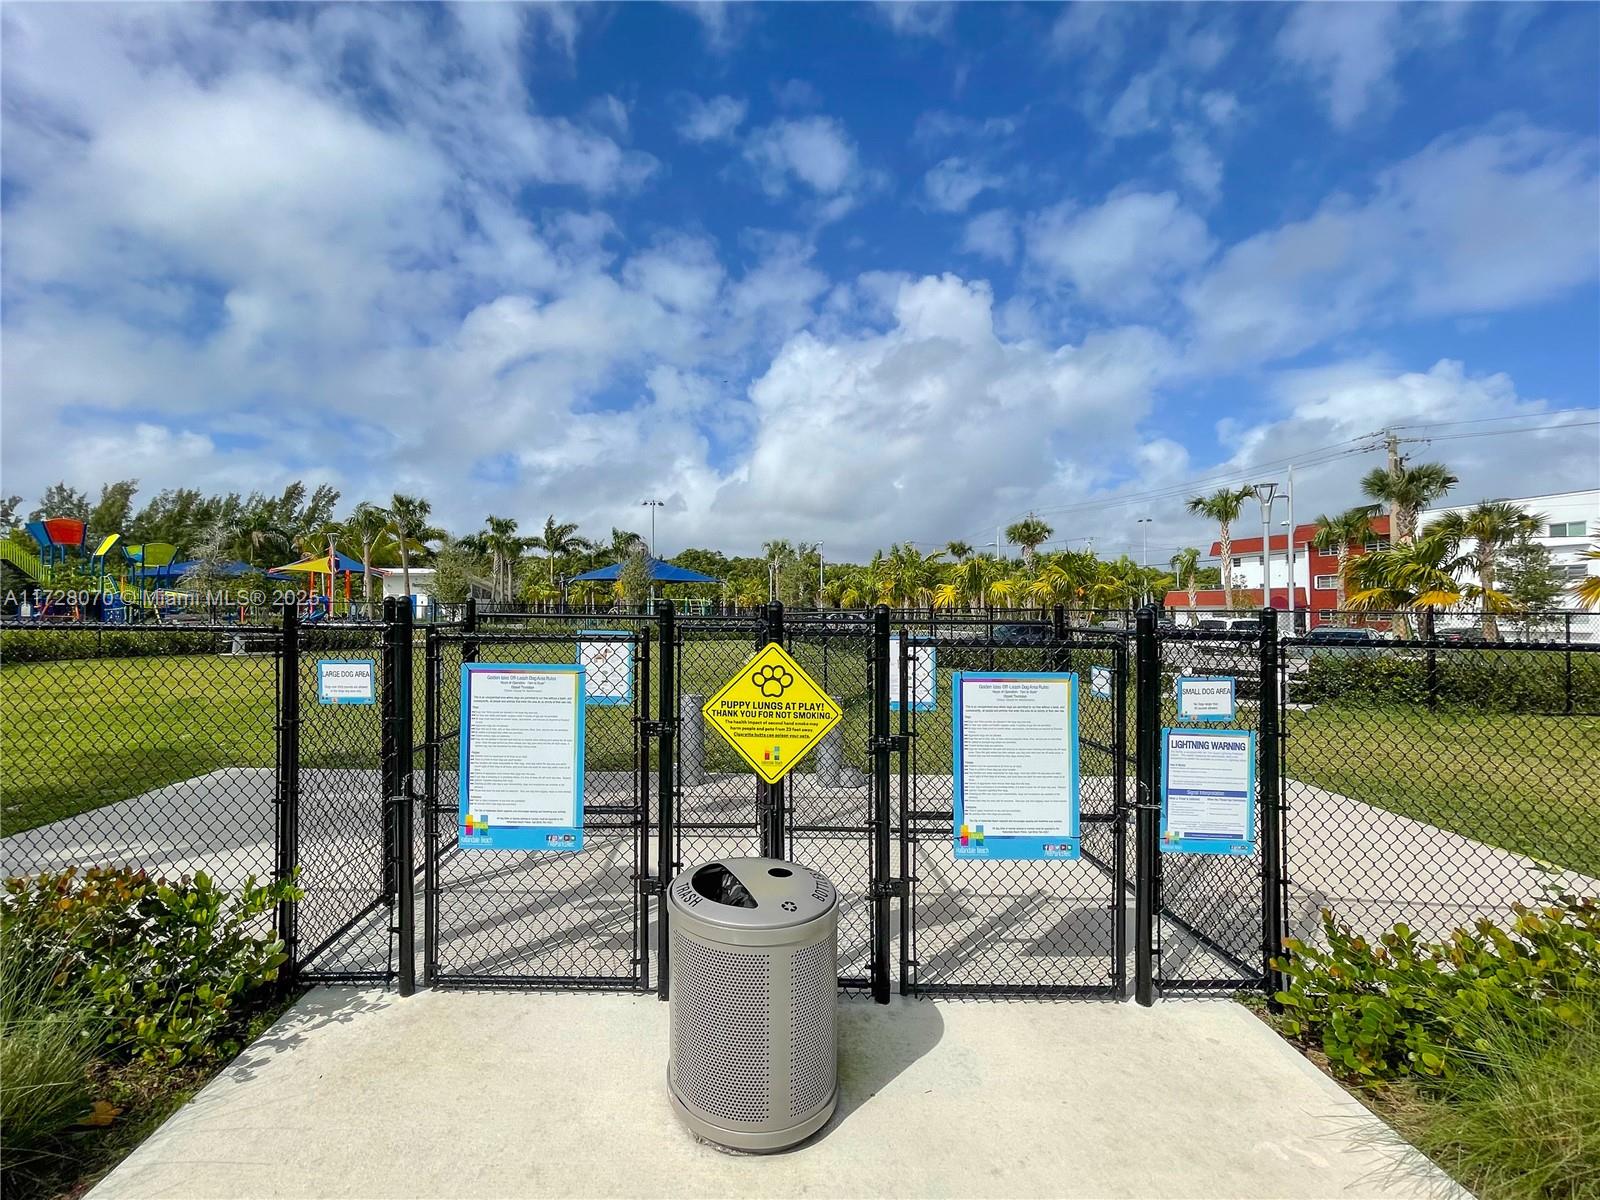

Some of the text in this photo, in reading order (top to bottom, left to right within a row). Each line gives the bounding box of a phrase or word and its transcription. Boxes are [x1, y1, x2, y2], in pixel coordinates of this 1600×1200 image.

[341, 670, 354, 678] DOG
[355, 670, 370, 678] AREA
[1182, 687, 1232, 695] SMALL DOG AREA
[720, 700, 825, 712] PUPPY LUNGS AT PLAY!
[712, 709, 833, 720] THANK YOU FOR NOT SMOKING.
[1171, 739, 1246, 751] LIGHTNING WARNING
[676, 882, 703, 907] TRASH
